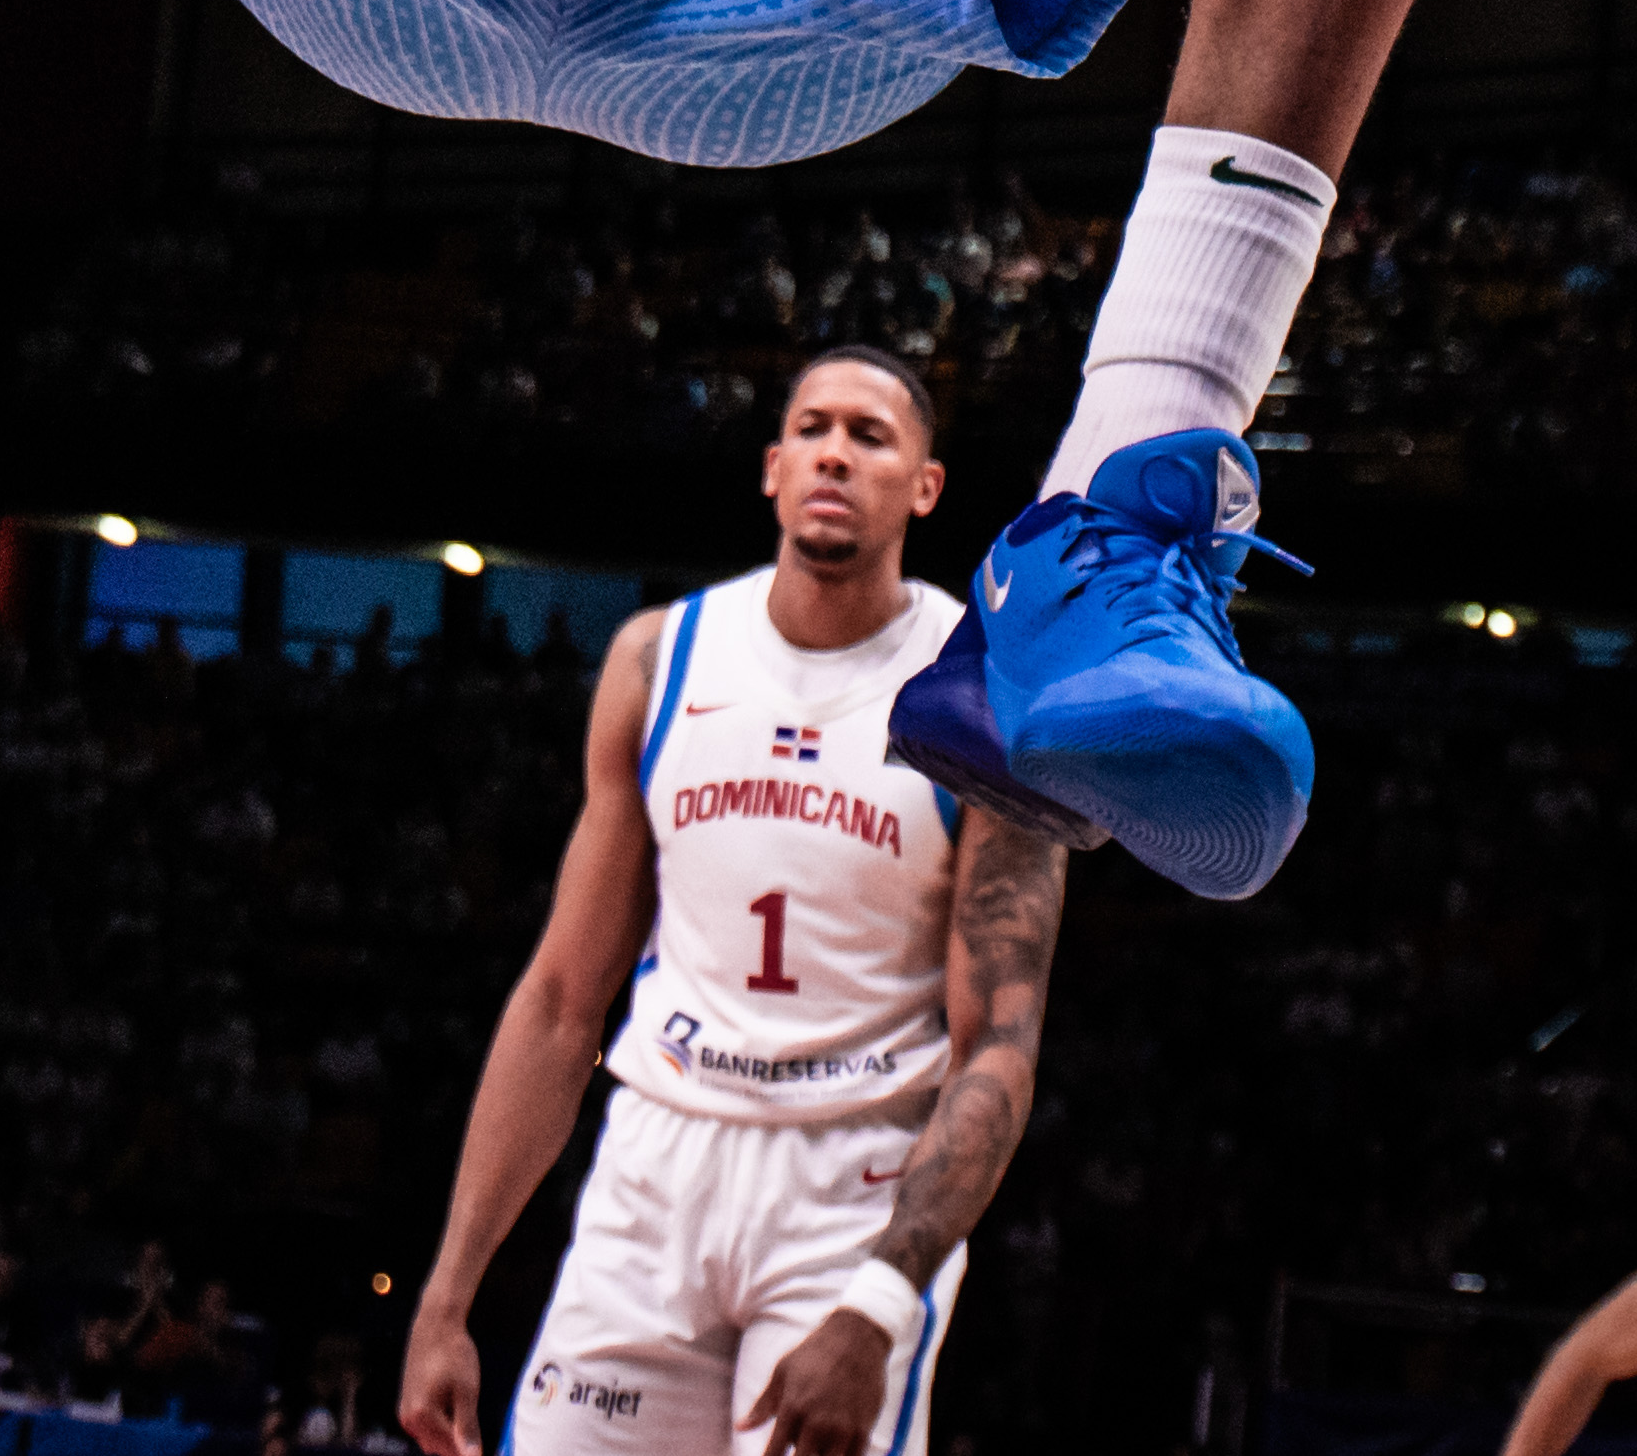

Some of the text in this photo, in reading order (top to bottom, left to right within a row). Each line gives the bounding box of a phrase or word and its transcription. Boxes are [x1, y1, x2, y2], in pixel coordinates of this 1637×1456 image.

[674, 778, 902, 859] DOMINICANA
[746, 890, 800, 996] 1
[699, 1046, 899, 1085] BANRESERVAS
